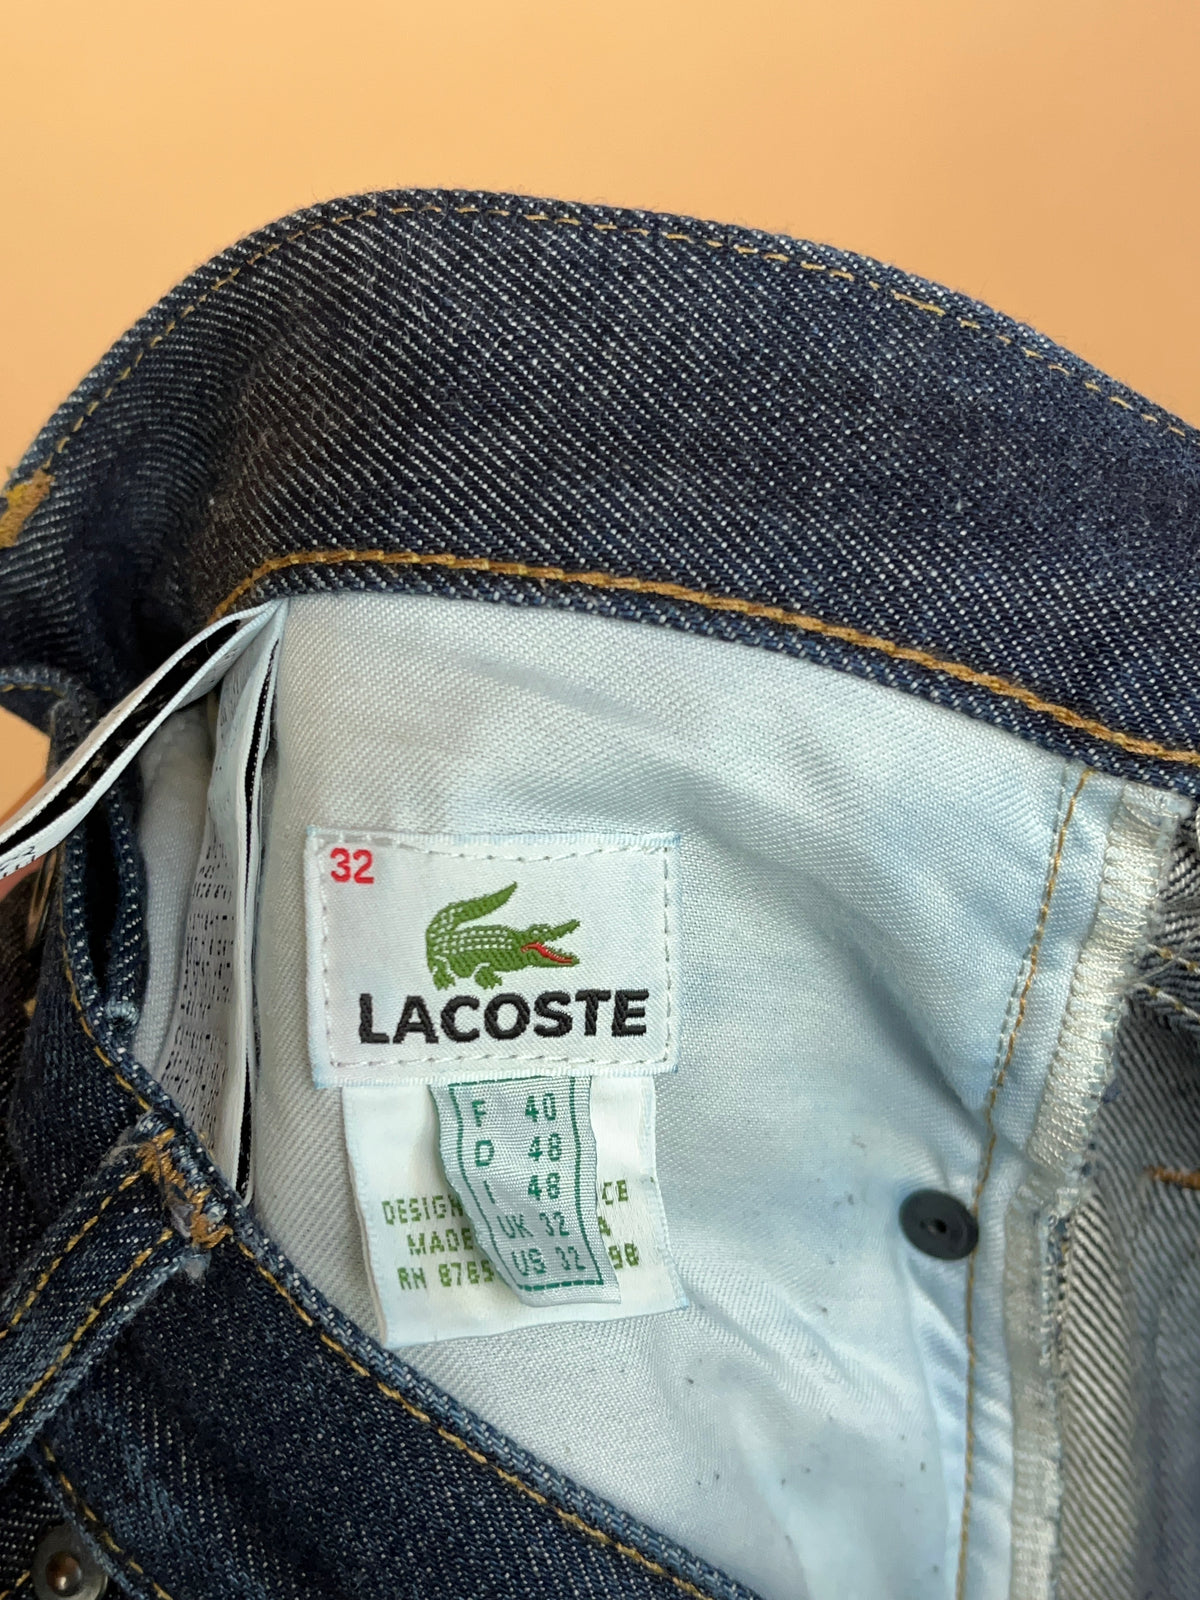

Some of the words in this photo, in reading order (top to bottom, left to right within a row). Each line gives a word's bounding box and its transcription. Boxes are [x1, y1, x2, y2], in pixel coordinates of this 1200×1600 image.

[330, 847, 375, 884] 32
[358, 988, 650, 1044] LACOSTE
[472, 1100, 486, 1128] F
[525, 1092, 557, 1122] 40
[474, 1139, 495, 1167] D
[528, 1132, 561, 1162] 48
[483, 1180, 496, 1205] I
[527, 1172, 560, 1200] 48
[407, 1226, 474, 1256] MADE
[497, 1213, 534, 1239] UK
[539, 1211, 570, 1237] 32
[511, 1248, 546, 1276] US
[555, 1245, 586, 1271] 32
